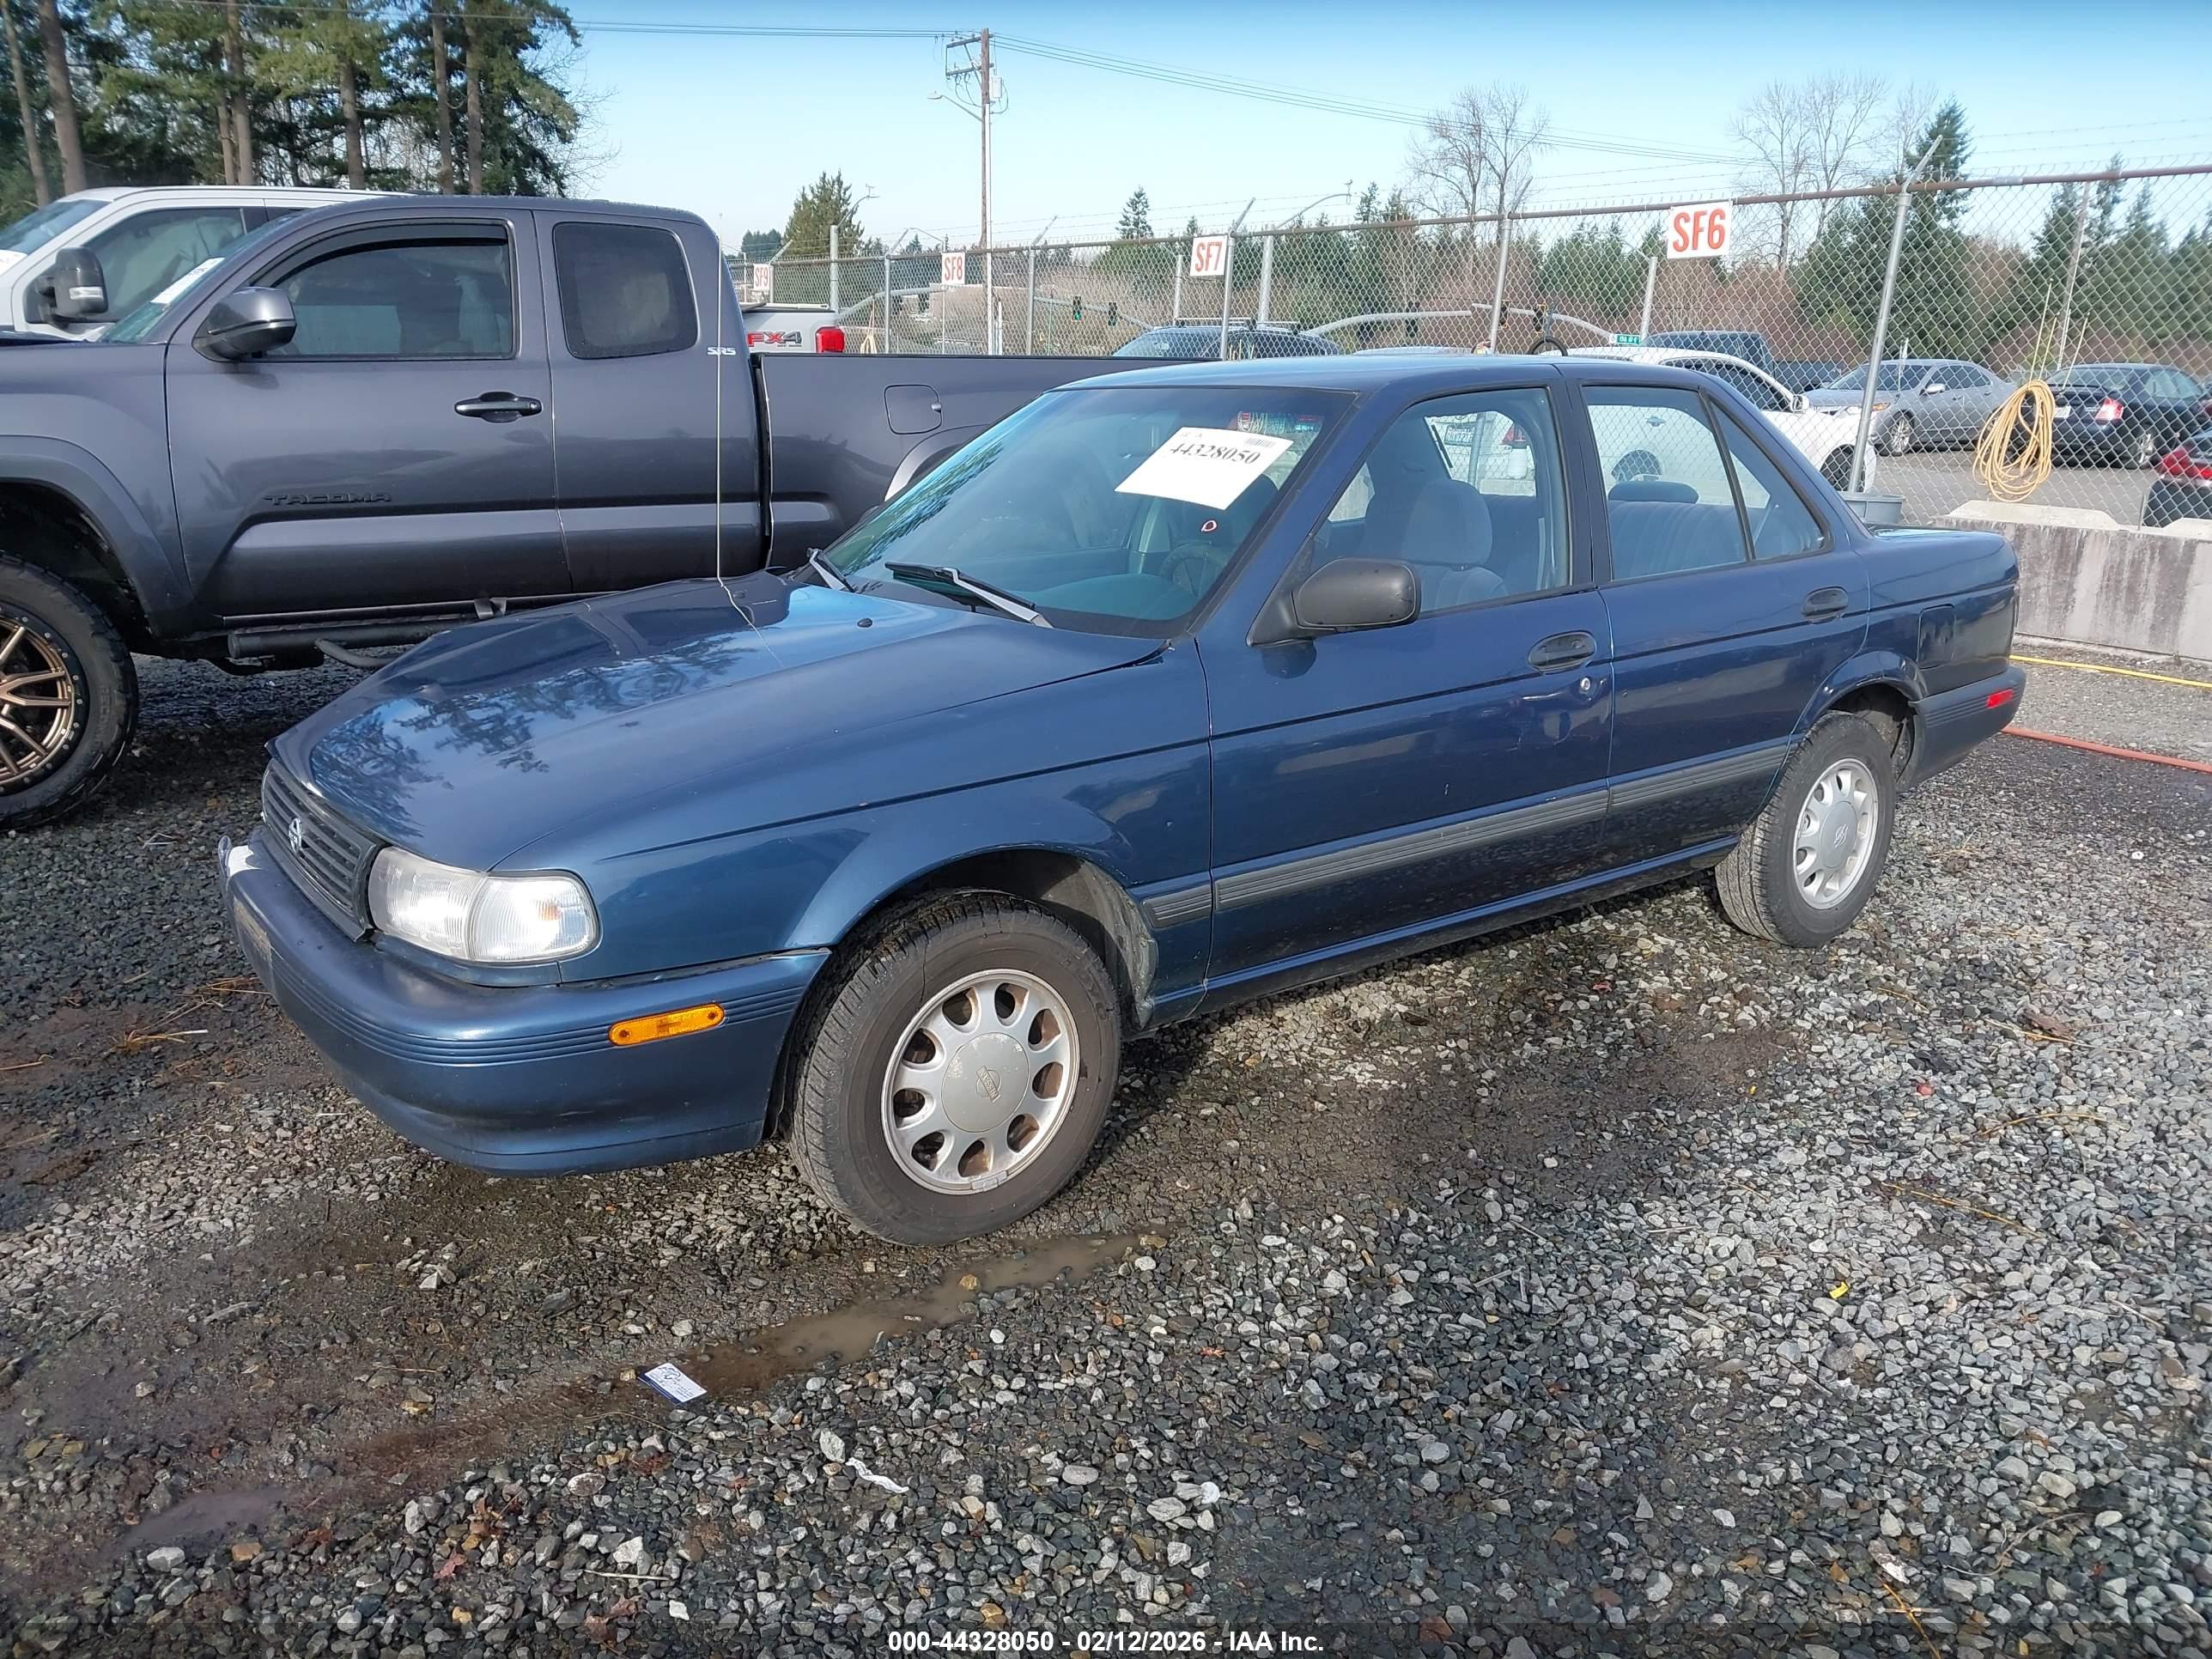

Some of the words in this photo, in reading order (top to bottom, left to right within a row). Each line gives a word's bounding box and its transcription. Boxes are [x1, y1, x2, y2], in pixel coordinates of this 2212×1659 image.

[1672, 209, 1726, 252] SF6
[1194, 240, 1223, 272] SF7
[756, 266, 769, 287] SF9
[945, 256, 963, 281] SF8
[747, 331, 802, 347] FX4
[1170, 442, 1261, 465] 44328050
[261, 492, 392, 506] TACOMA
[977, 1067, 998, 1100] NISSAN
